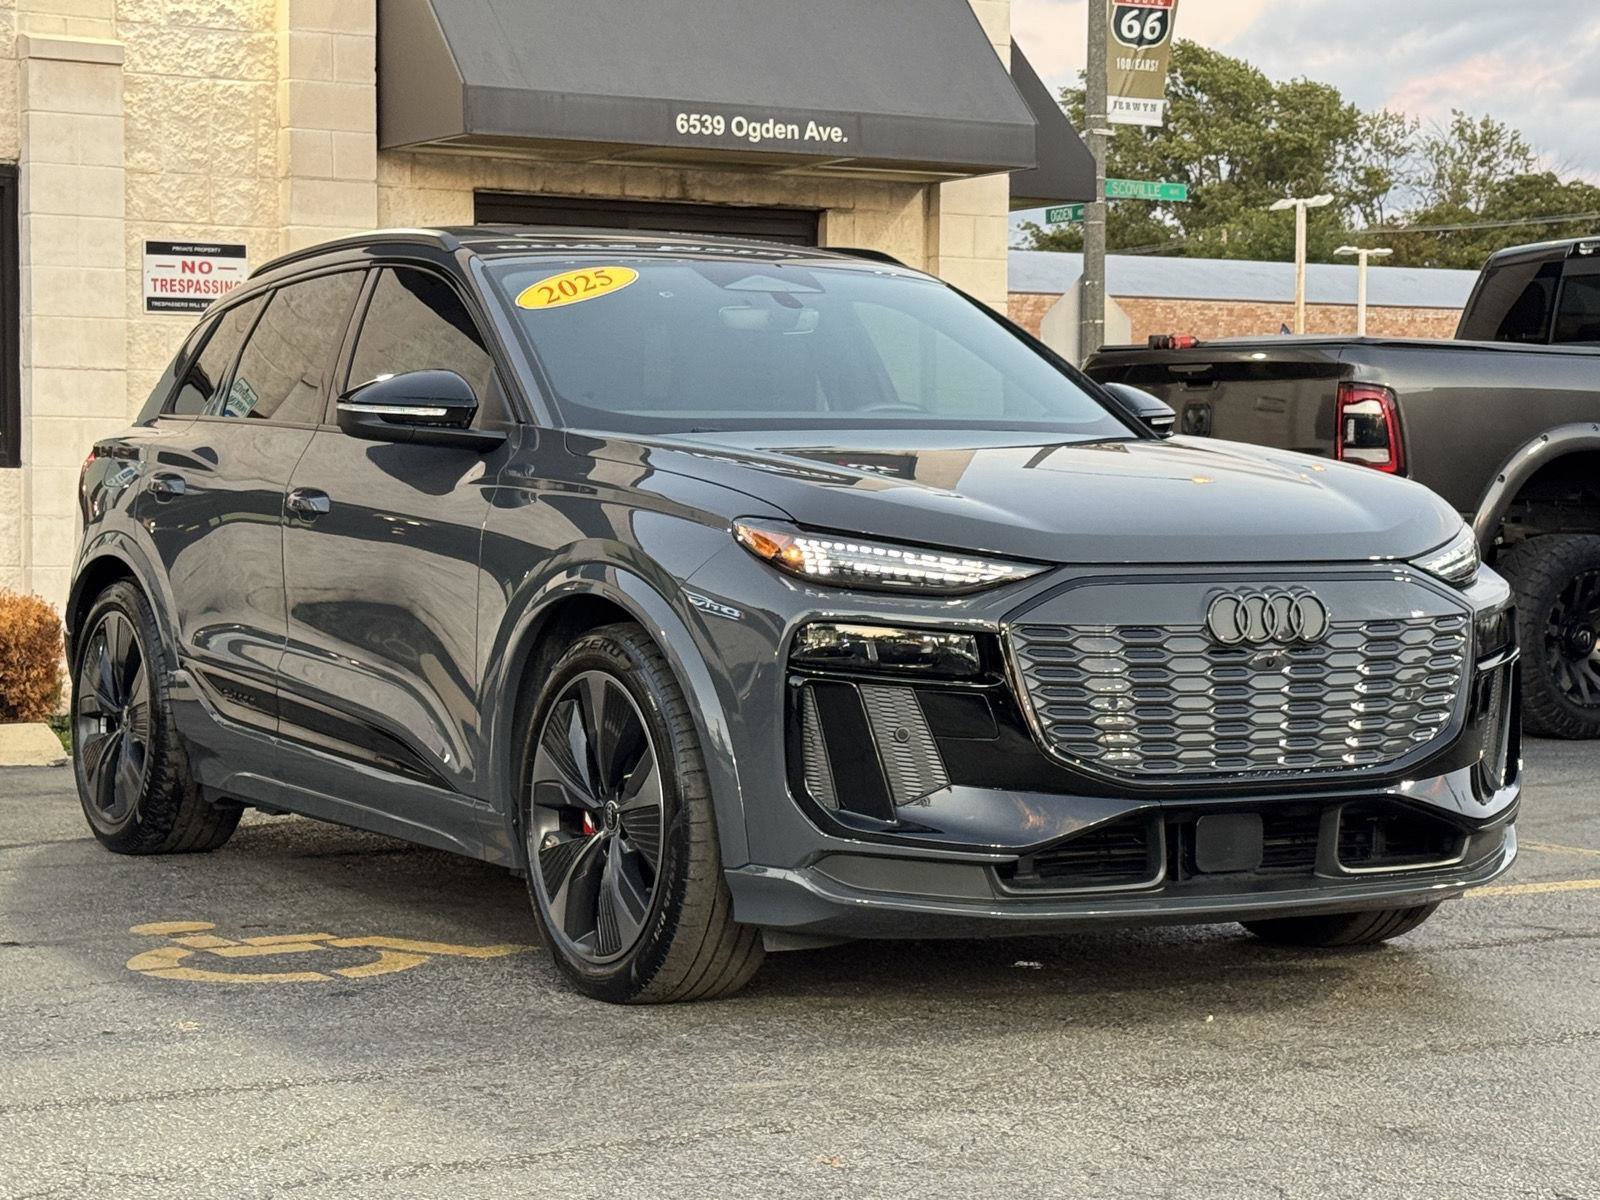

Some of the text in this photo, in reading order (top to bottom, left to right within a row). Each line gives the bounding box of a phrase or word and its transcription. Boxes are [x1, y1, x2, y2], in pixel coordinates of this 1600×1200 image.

[1120, 9, 1163, 40] 66
[675, 112, 849, 143] 6539 Ogden Ave.
[1111, 180, 1161, 196] SCOVILLE
[1050, 207, 1073, 222] OGDEN
[171, 245, 221, 254] PRIVATE PROPERTY
[181, 260, 213, 275] NO
[537, 270, 613, 304] 2025
